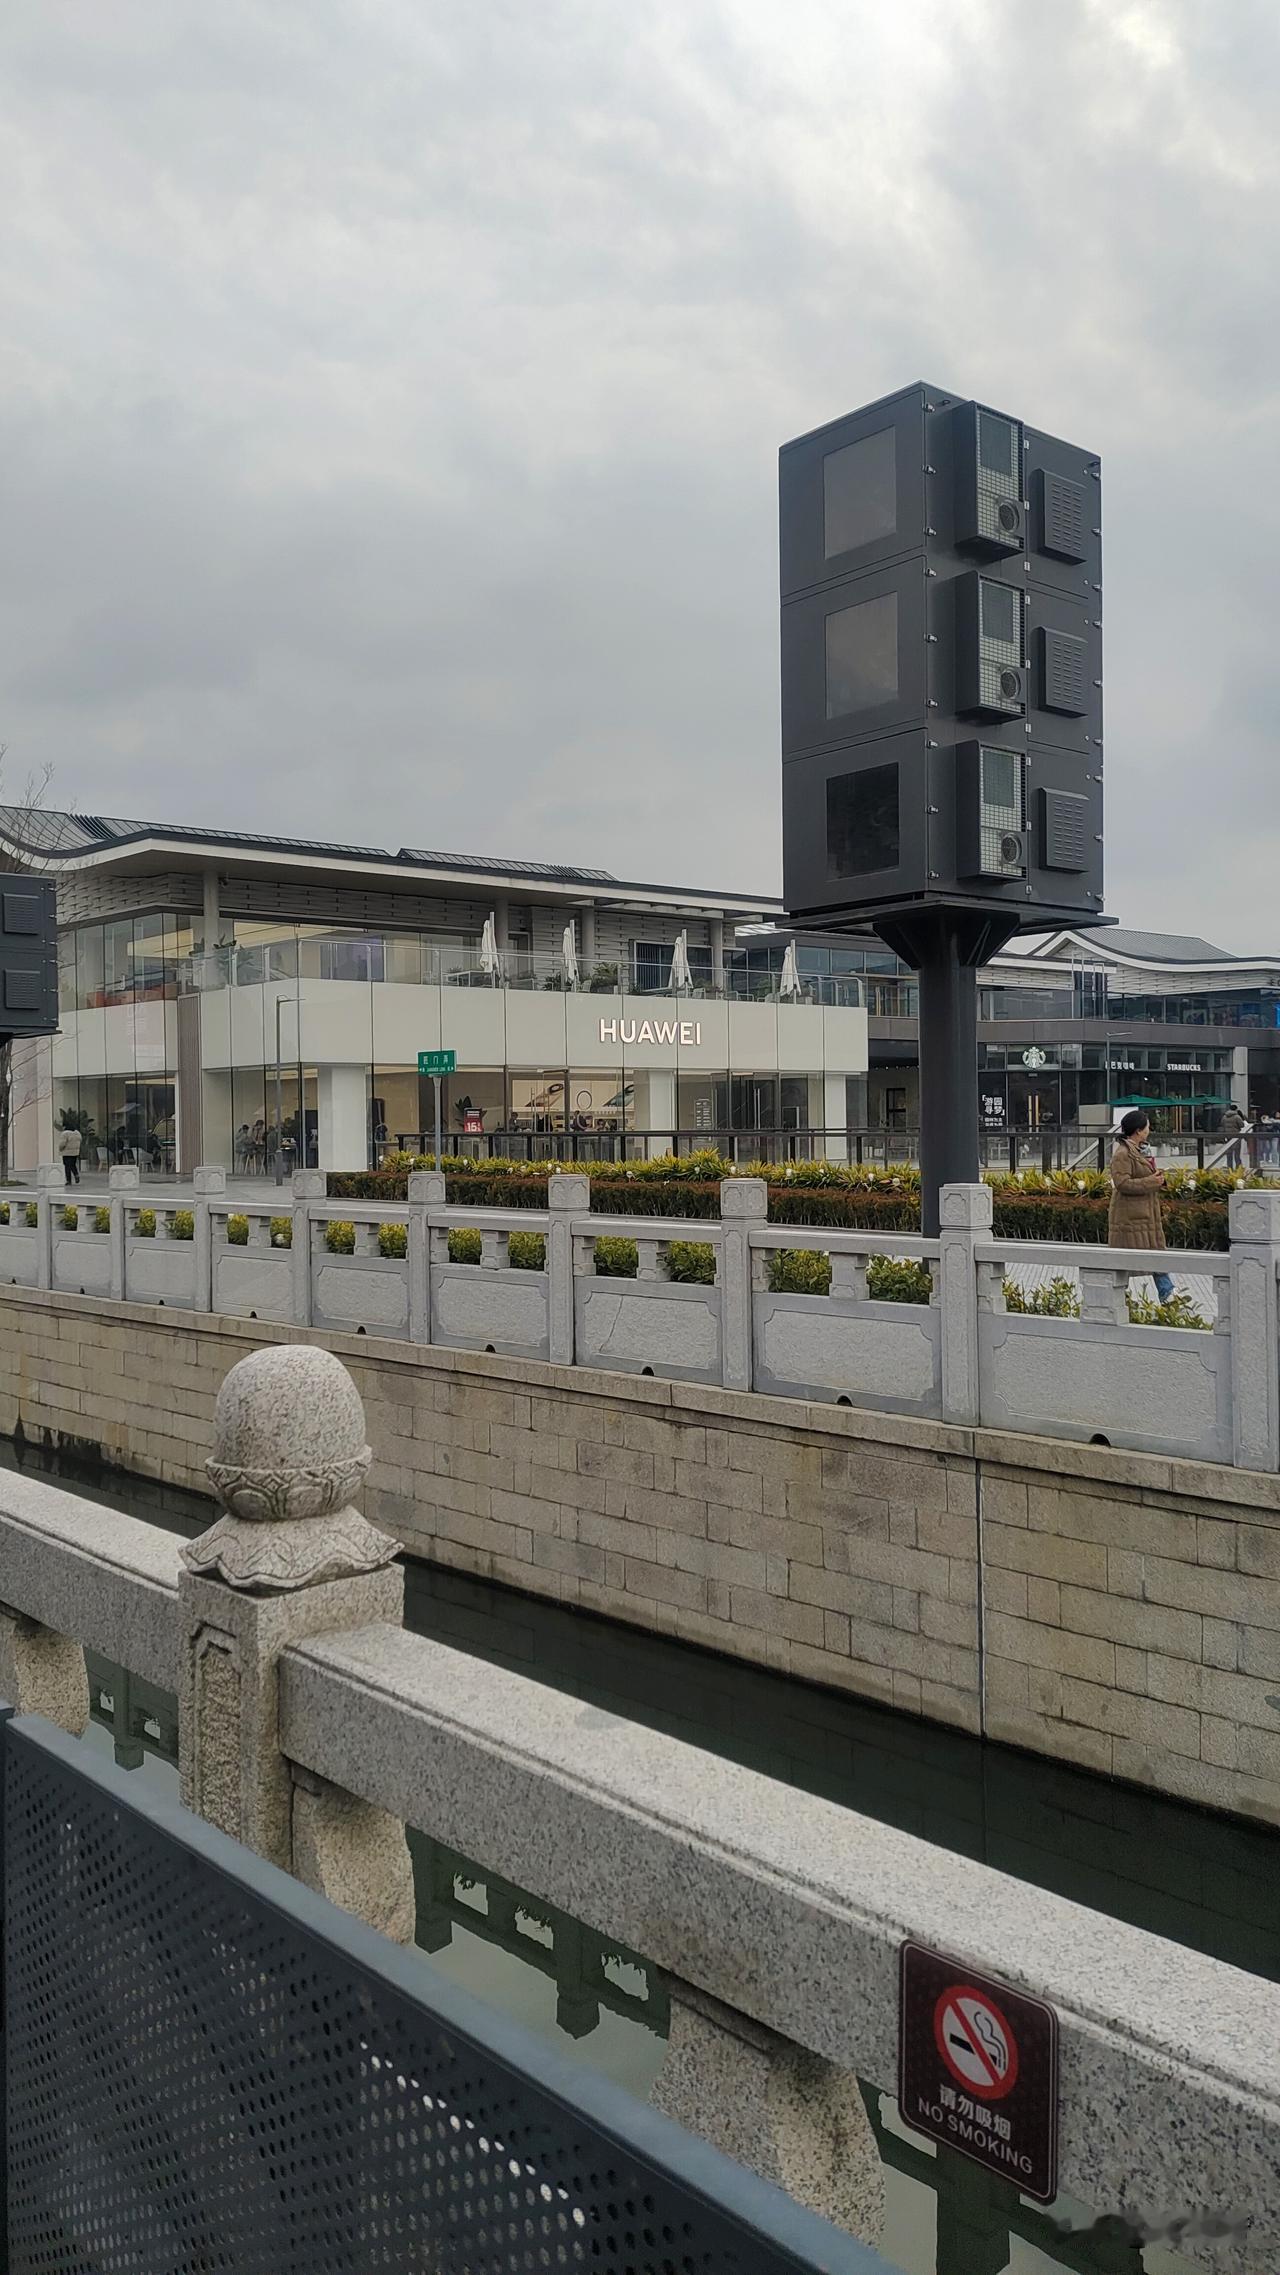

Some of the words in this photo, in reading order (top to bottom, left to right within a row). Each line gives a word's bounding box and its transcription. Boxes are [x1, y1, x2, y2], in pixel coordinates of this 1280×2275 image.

[600, 1018, 701, 1045] HUAWEI
[1167, 1063, 1201, 1072] STARBUCKS
[940, 2083, 1011, 2141] 请勿吸烟
[918, 2096, 944, 2122] NO
[948, 2114, 1033, 2175] SMOKING
